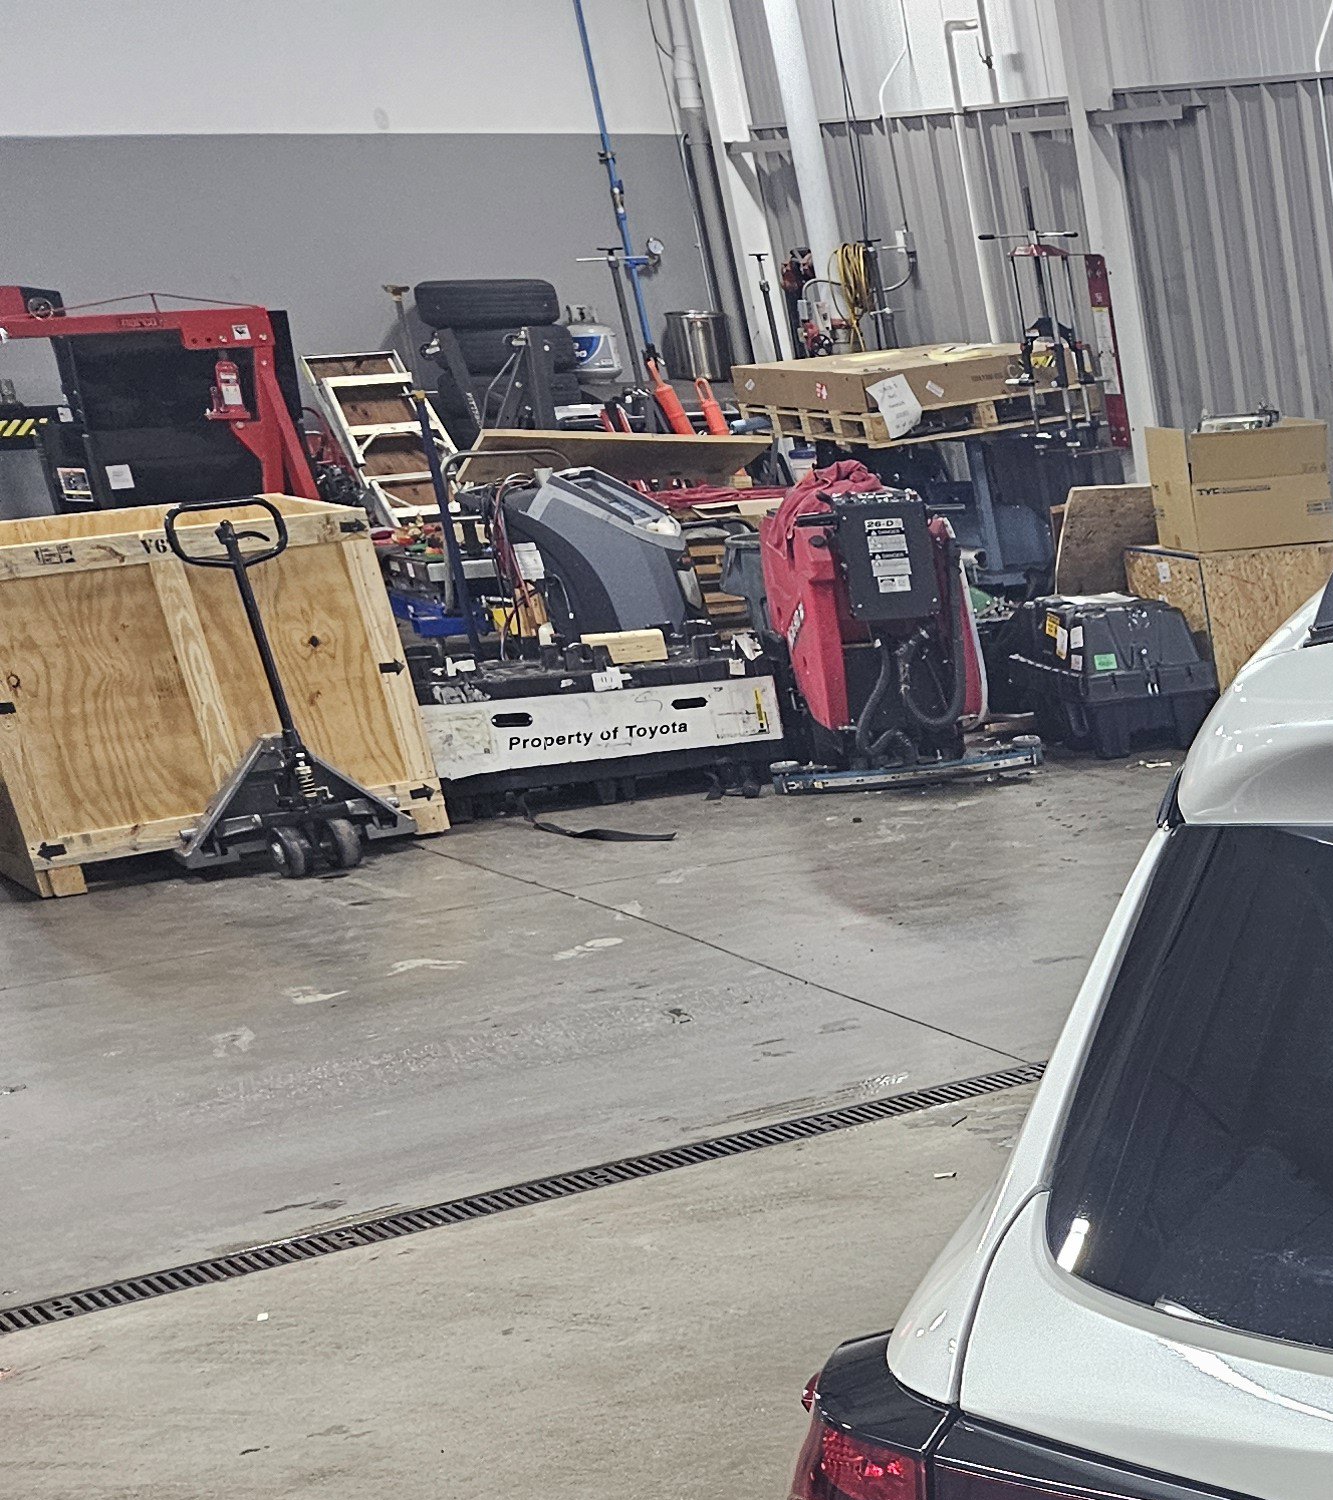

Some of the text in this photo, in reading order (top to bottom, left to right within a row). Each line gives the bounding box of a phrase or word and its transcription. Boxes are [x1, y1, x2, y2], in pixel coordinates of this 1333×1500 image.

[509, 721, 688, 750] Property of Toyota
